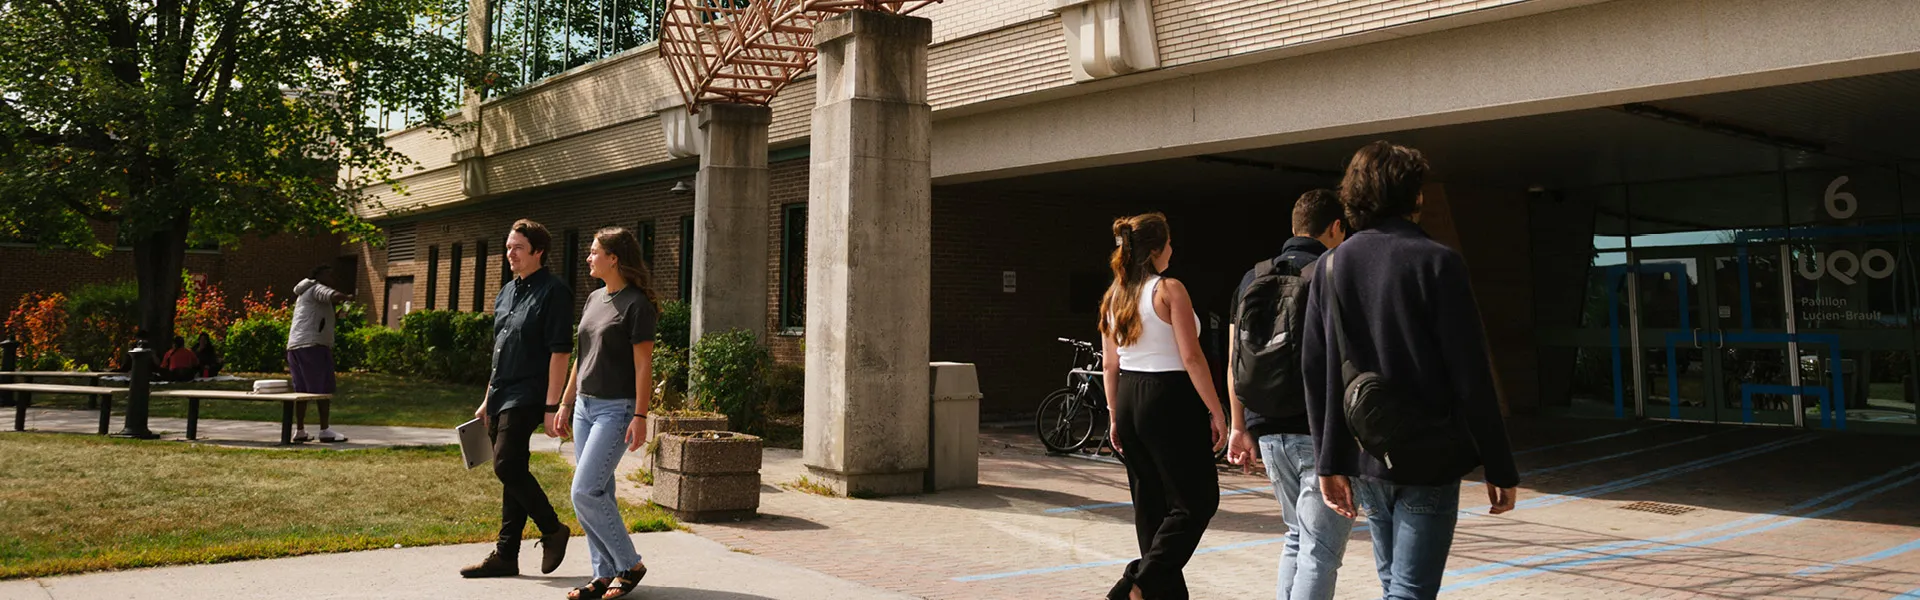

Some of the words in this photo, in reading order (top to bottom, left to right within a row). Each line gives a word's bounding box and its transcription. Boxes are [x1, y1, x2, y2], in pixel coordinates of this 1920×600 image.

[1824, 175, 1858, 219] 6
[1798, 248, 1896, 285] UQO
[1801, 296, 1847, 307] Pavillon
[1802, 310, 1881, 321] Lucien-Brault
